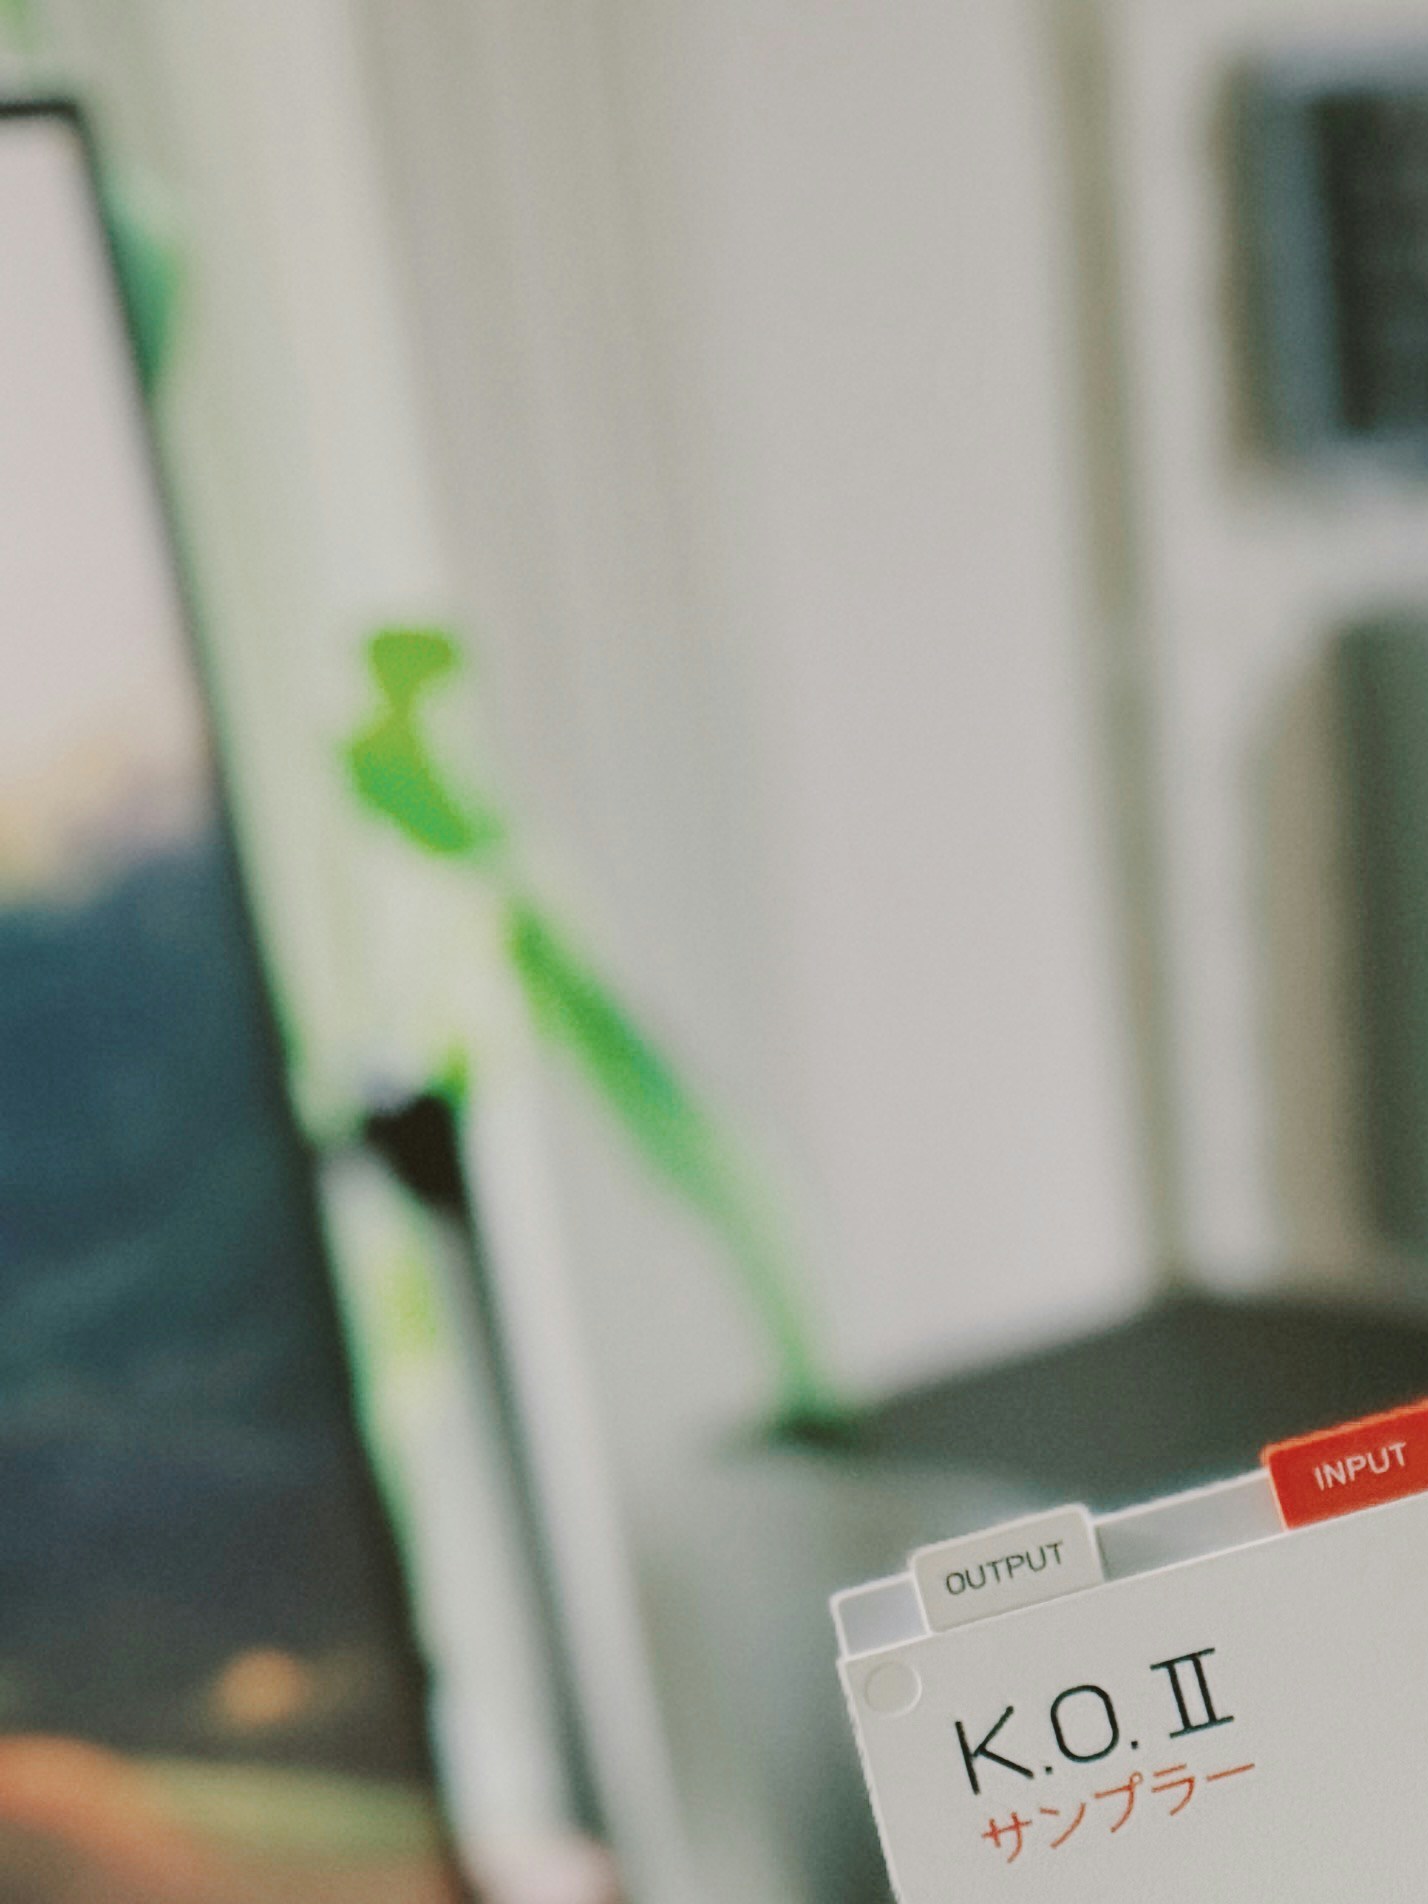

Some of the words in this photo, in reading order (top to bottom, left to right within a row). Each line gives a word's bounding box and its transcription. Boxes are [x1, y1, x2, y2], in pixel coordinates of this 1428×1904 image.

[1312, 1442, 1408, 1492] INPUT
[945, 1540, 1065, 1597] OUTPUT
[953, 1683, 1140, 1796] K.O.
[980, 1761, 1257, 1864] サンプラー
